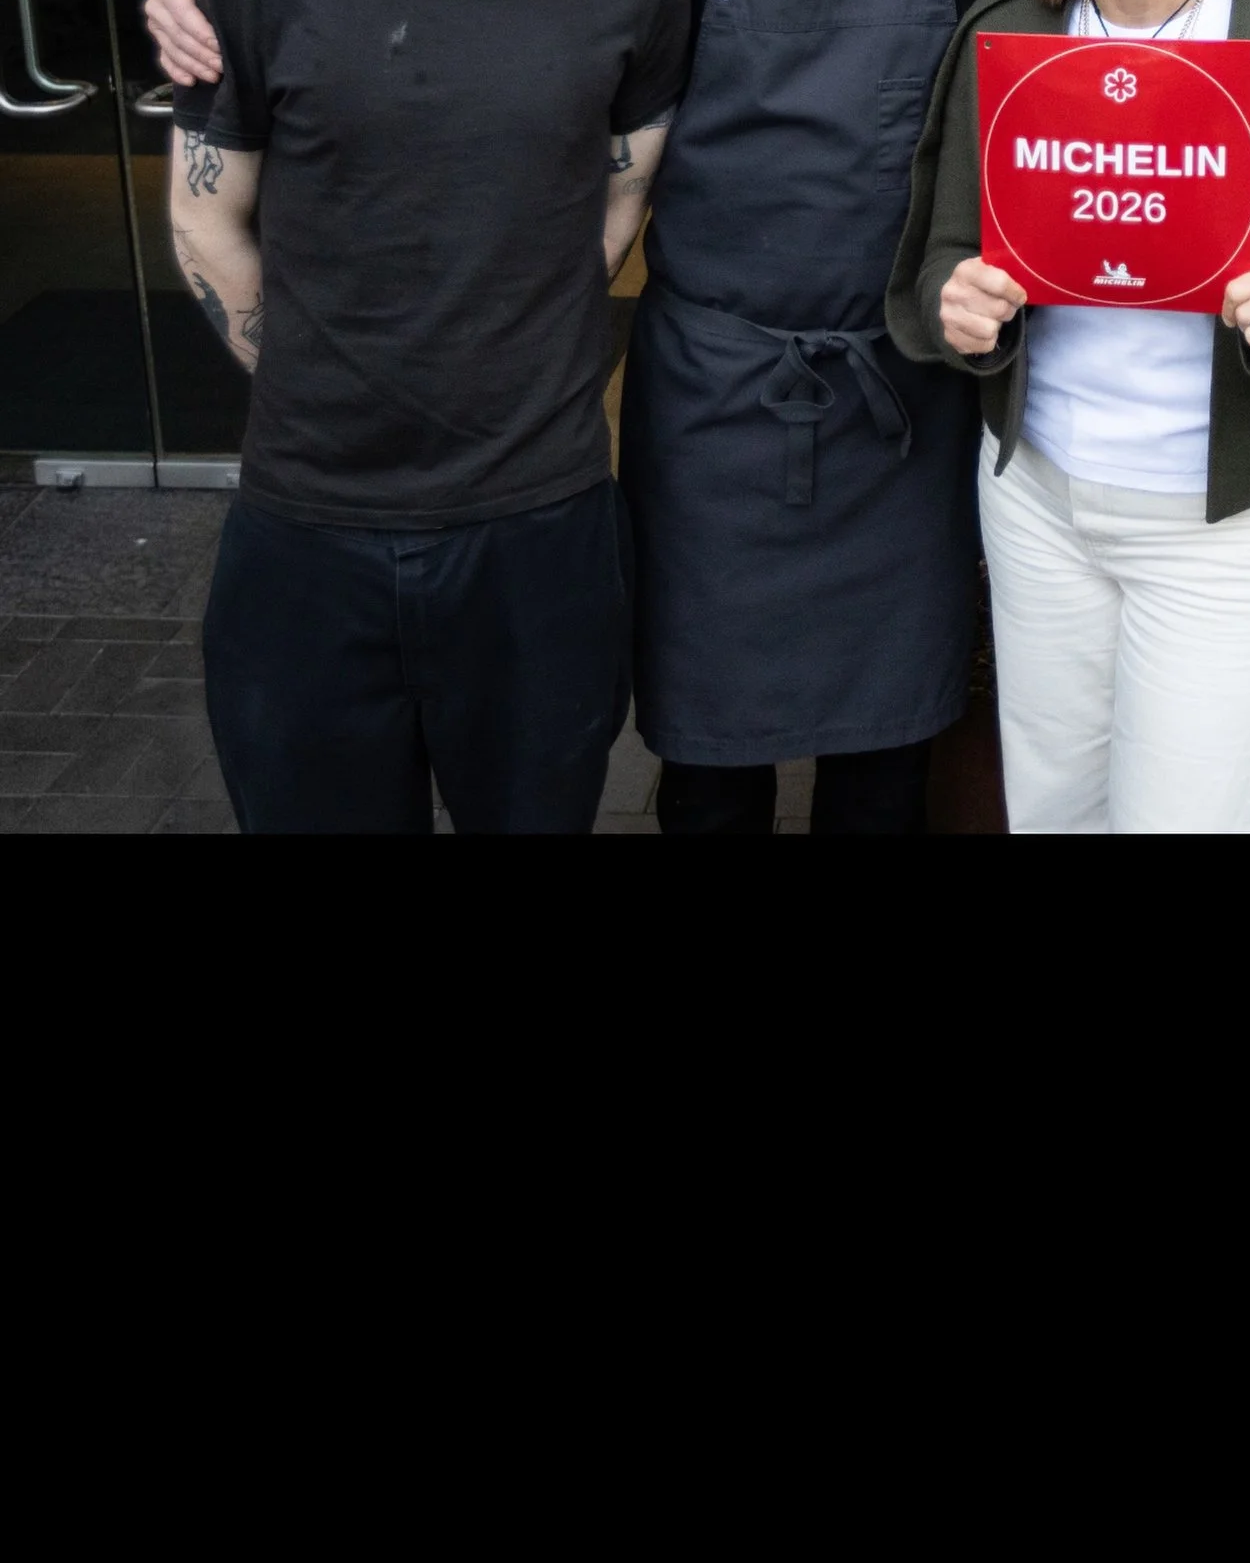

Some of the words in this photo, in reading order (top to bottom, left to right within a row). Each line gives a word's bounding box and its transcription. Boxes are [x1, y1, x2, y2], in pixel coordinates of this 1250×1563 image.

[1015, 137, 1226, 177] MICHELIN
[1073, 189, 1167, 223] 2026
[1093, 277, 1146, 287] MICHELIN
